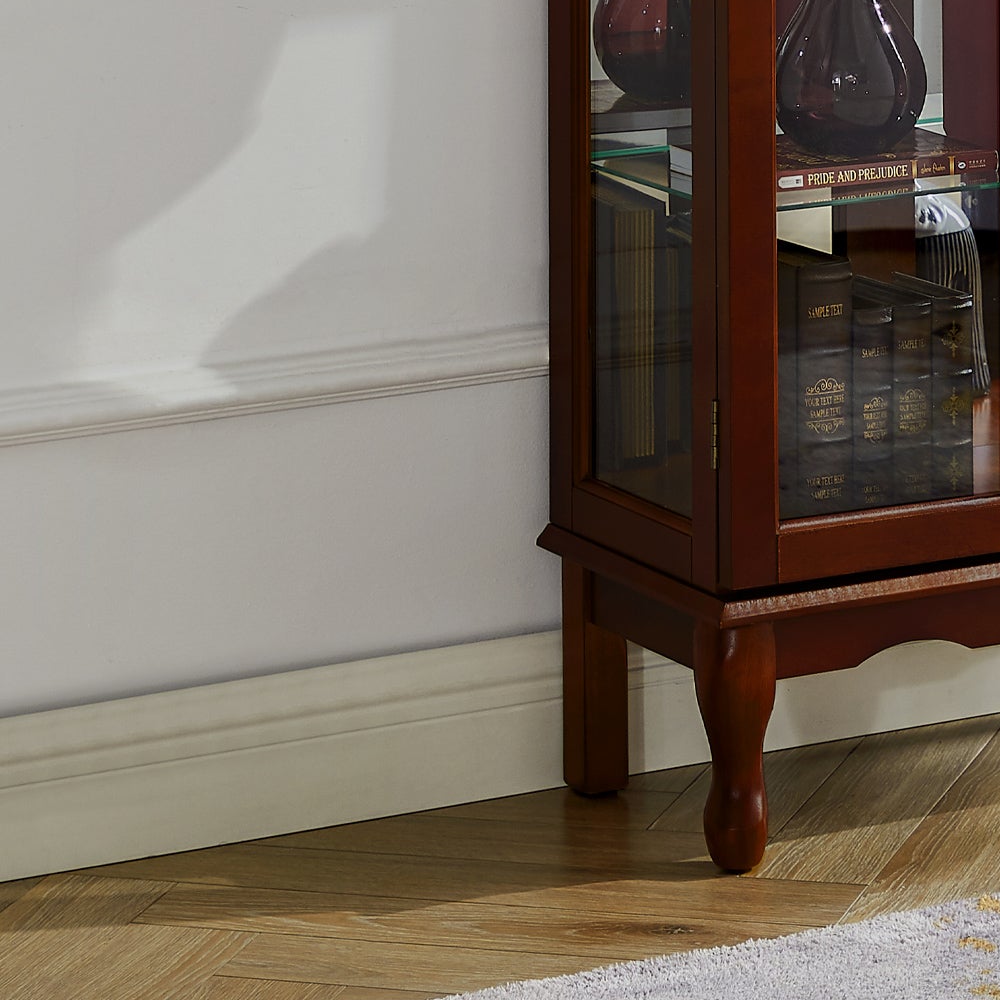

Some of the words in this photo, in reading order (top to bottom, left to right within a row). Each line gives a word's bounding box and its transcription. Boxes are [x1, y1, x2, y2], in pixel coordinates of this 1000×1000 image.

[808, 171, 836, 186] PRIDE
[837, 169, 857, 183] AND
[858, 165, 909, 181] PREJUDICE
[808, 305, 829, 318] SAMPLE
[830, 303, 843, 316] TEXT
[805, 397, 820, 407] YOUR
[820, 396, 832, 406] TEXT
[810, 408, 829, 418] SAMPLE
[830, 406, 842, 416] TEXT
